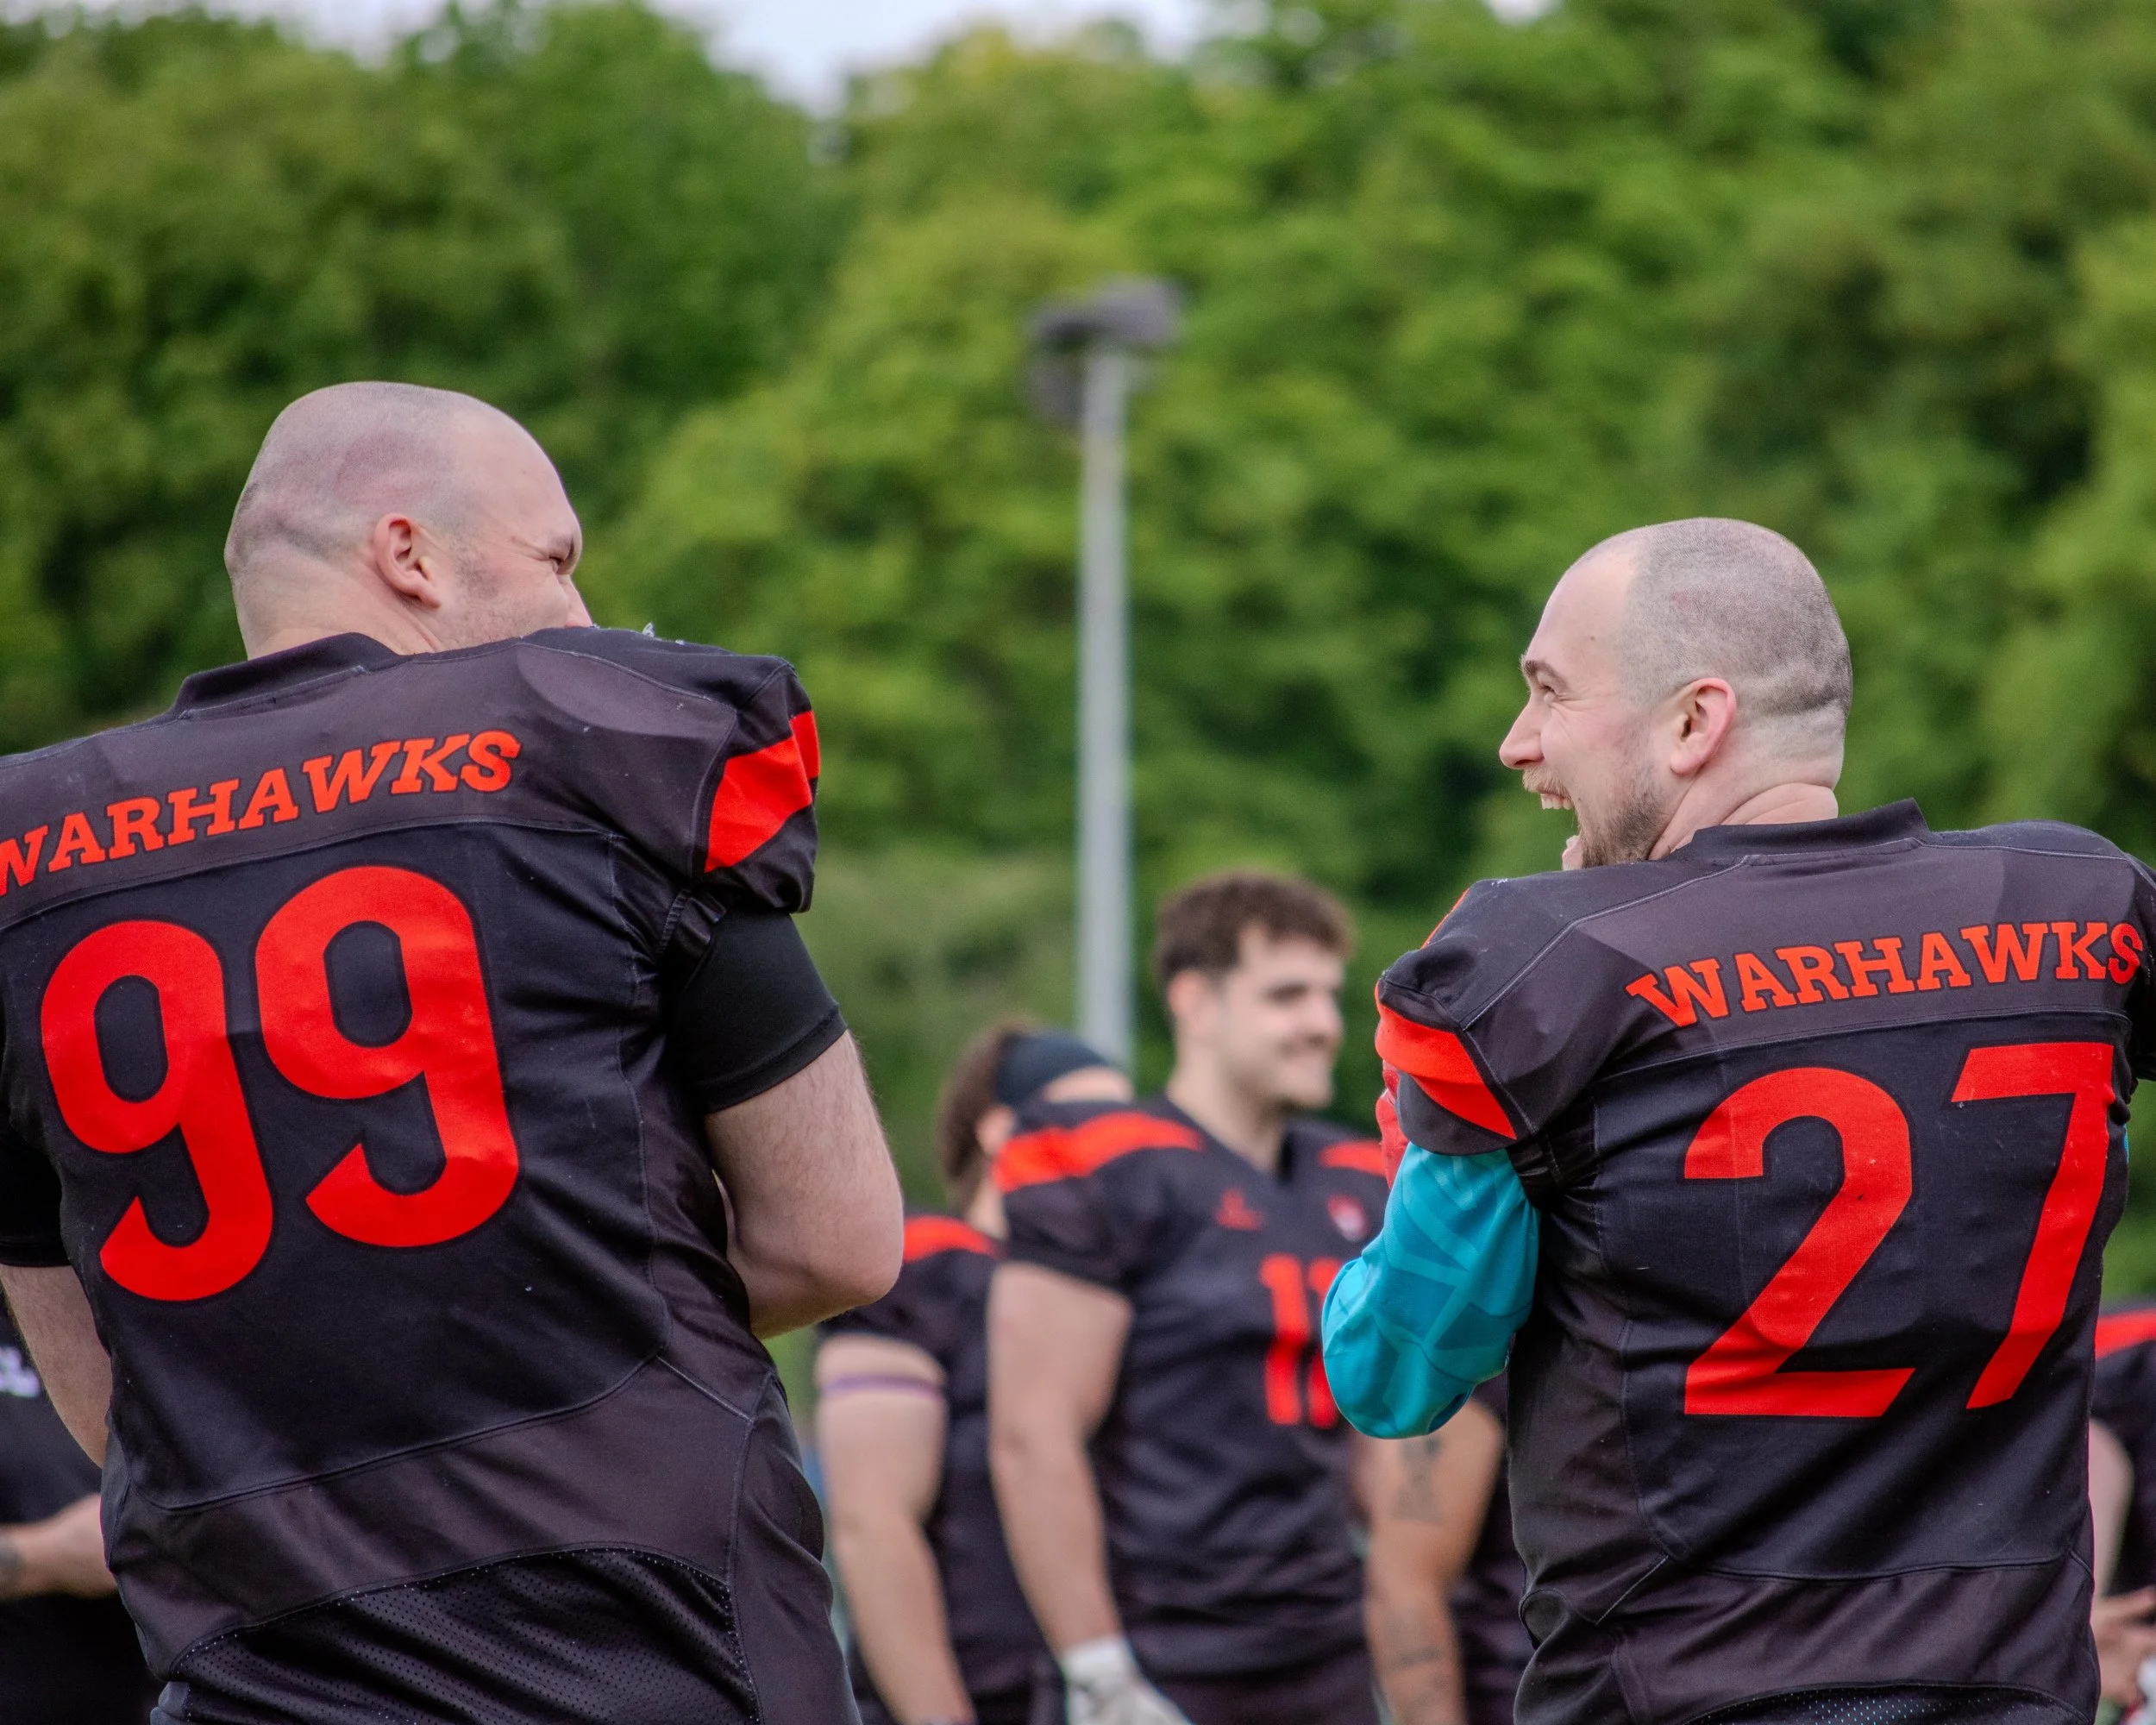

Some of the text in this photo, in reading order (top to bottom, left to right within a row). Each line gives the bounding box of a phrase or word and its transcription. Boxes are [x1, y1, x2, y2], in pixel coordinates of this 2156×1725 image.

[40, 865, 521, 1302] 99
[1626, 921, 2144, 1028] WARHAWKS
[1683, 1040, 2115, 1418] 27
